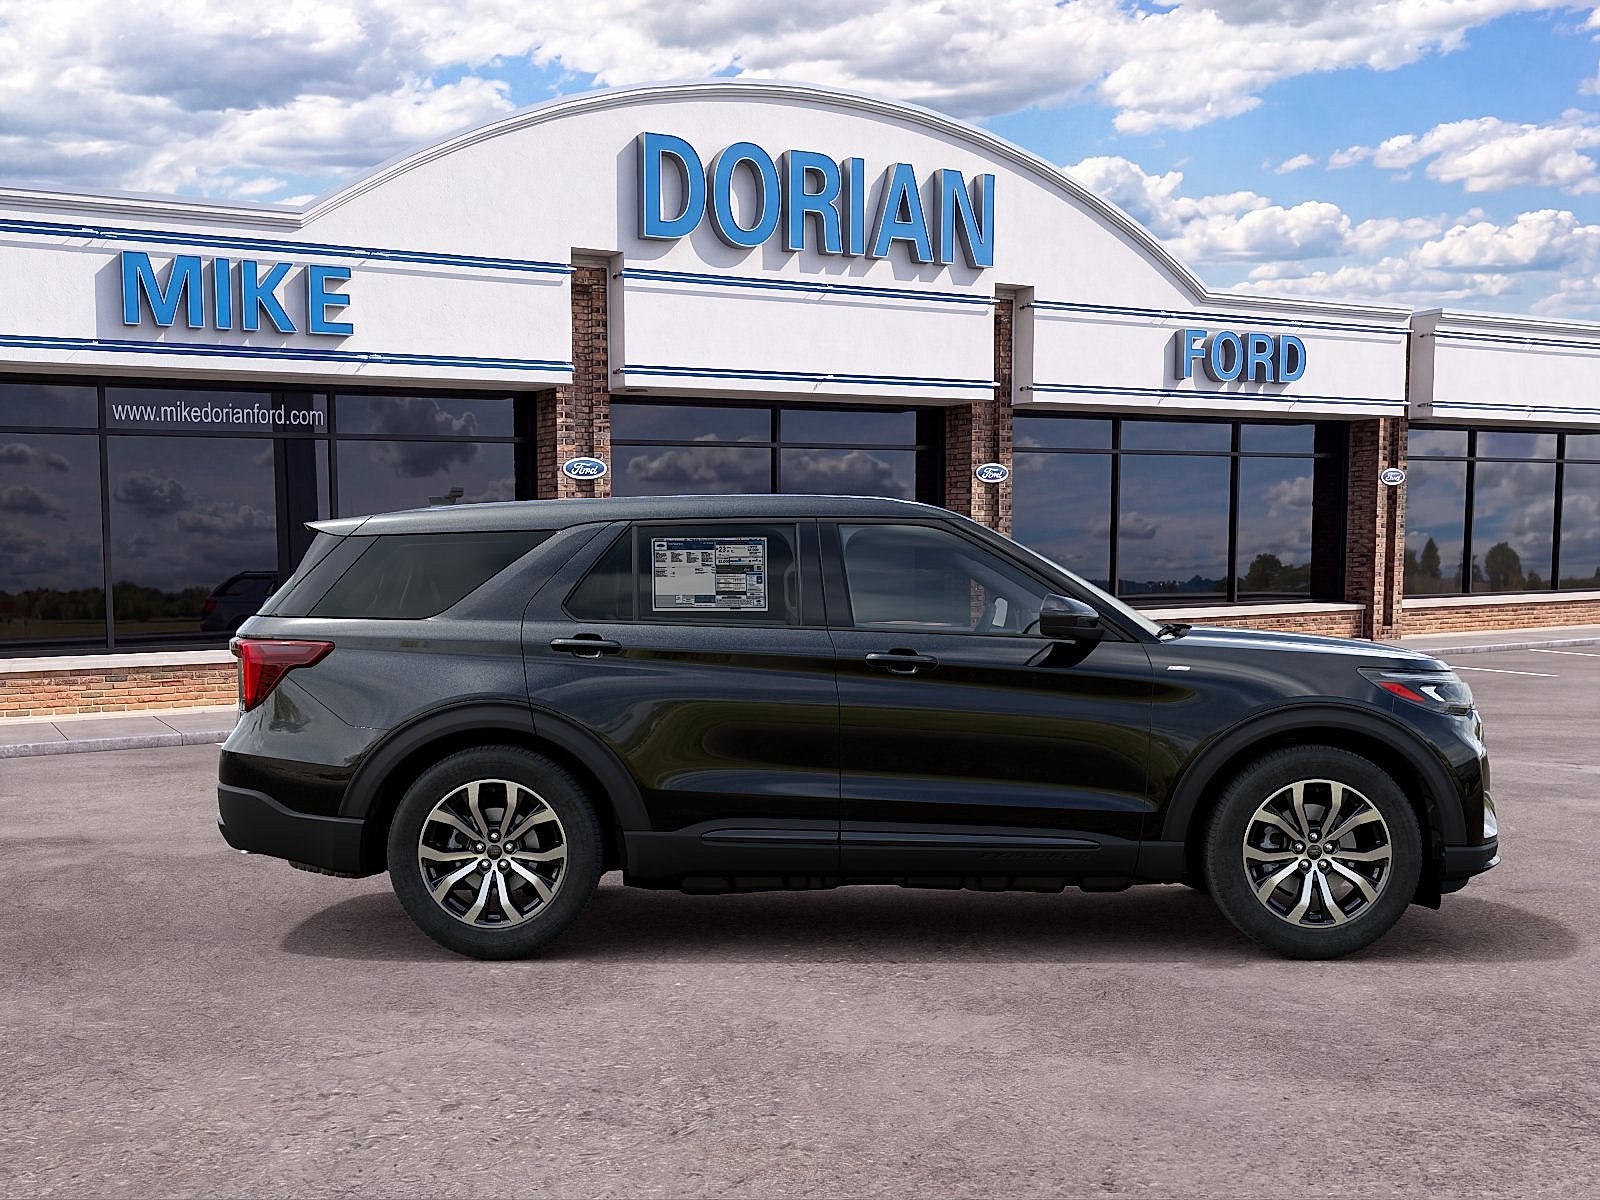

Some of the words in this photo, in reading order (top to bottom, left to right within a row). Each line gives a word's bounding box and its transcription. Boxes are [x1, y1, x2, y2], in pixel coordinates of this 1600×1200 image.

[639, 131, 995, 269] DORIAN
[121, 250, 354, 336] MIKE
[1177, 328, 1307, 382] FORD
[112, 401, 325, 426] www.mikedorianford.com
[571, 462, 599, 474] Ford
[982, 467, 1003, 479] Ford
